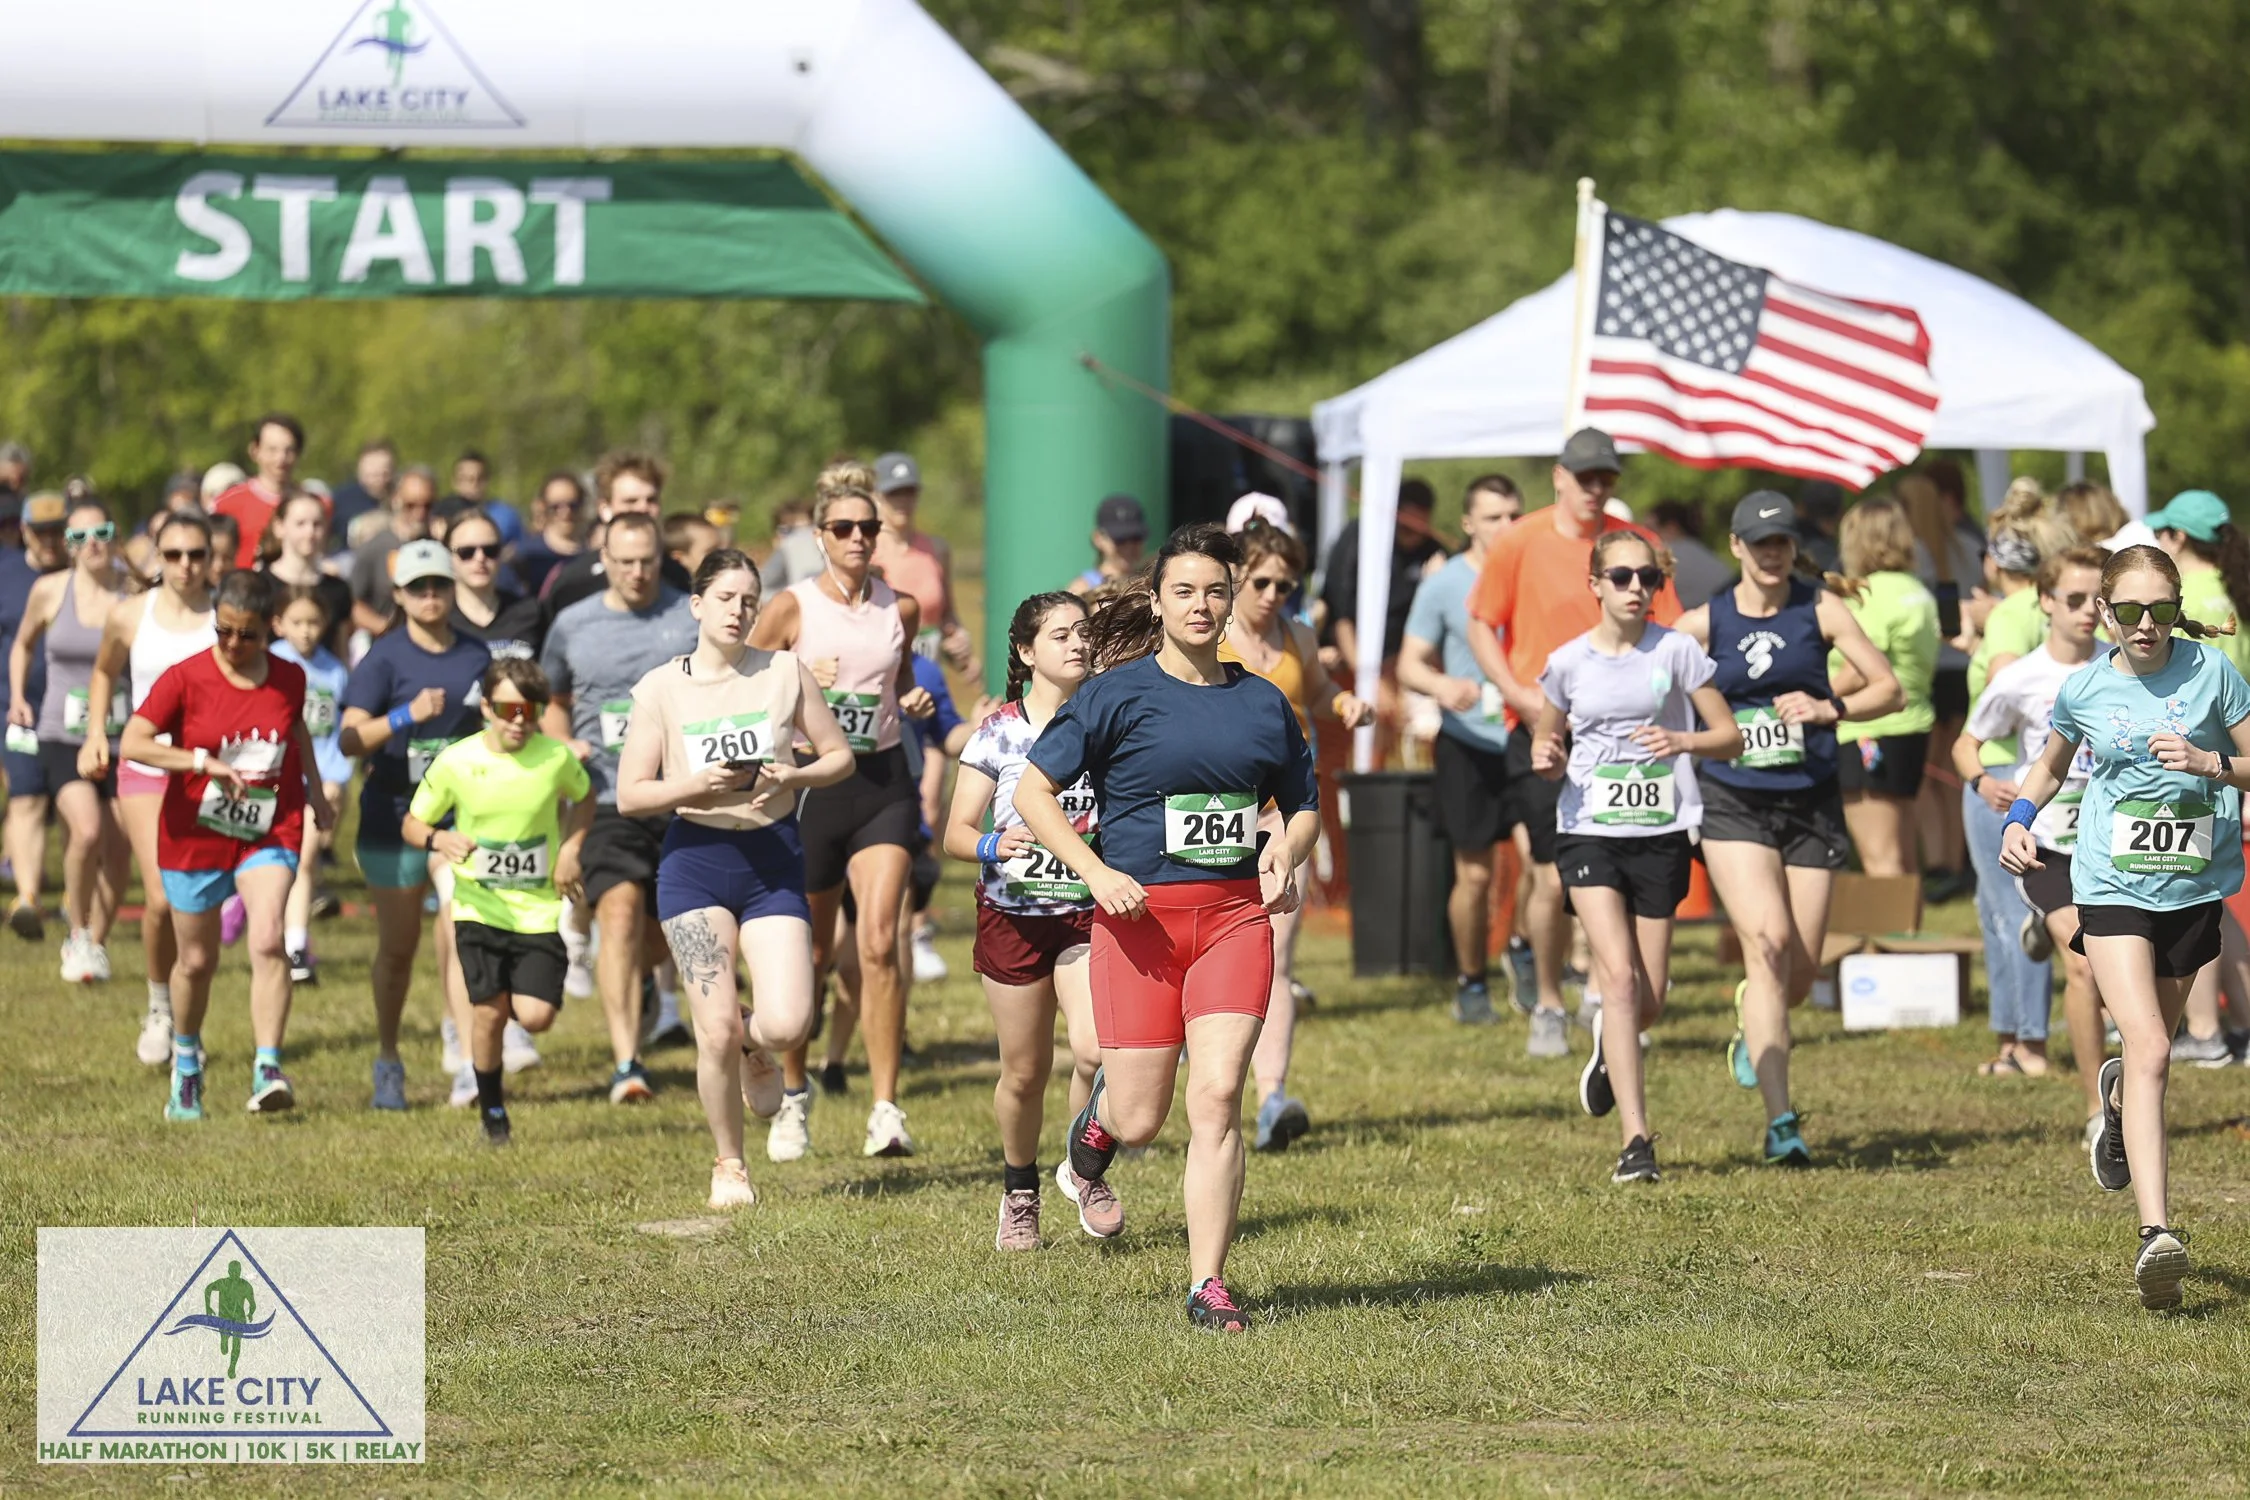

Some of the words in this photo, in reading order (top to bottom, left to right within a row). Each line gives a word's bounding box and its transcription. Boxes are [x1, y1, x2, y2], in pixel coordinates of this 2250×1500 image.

[317, 89, 391, 111] LAKE
[401, 89, 469, 111] CITY
[174, 170, 613, 287] START
[701, 730, 758, 763] 260
[212, 795, 260, 825] 268
[1607, 783, 1660, 807] 208
[1183, 813, 1245, 846] 264
[2129, 820, 2196, 853] 207
[488, 853, 536, 876] 294
